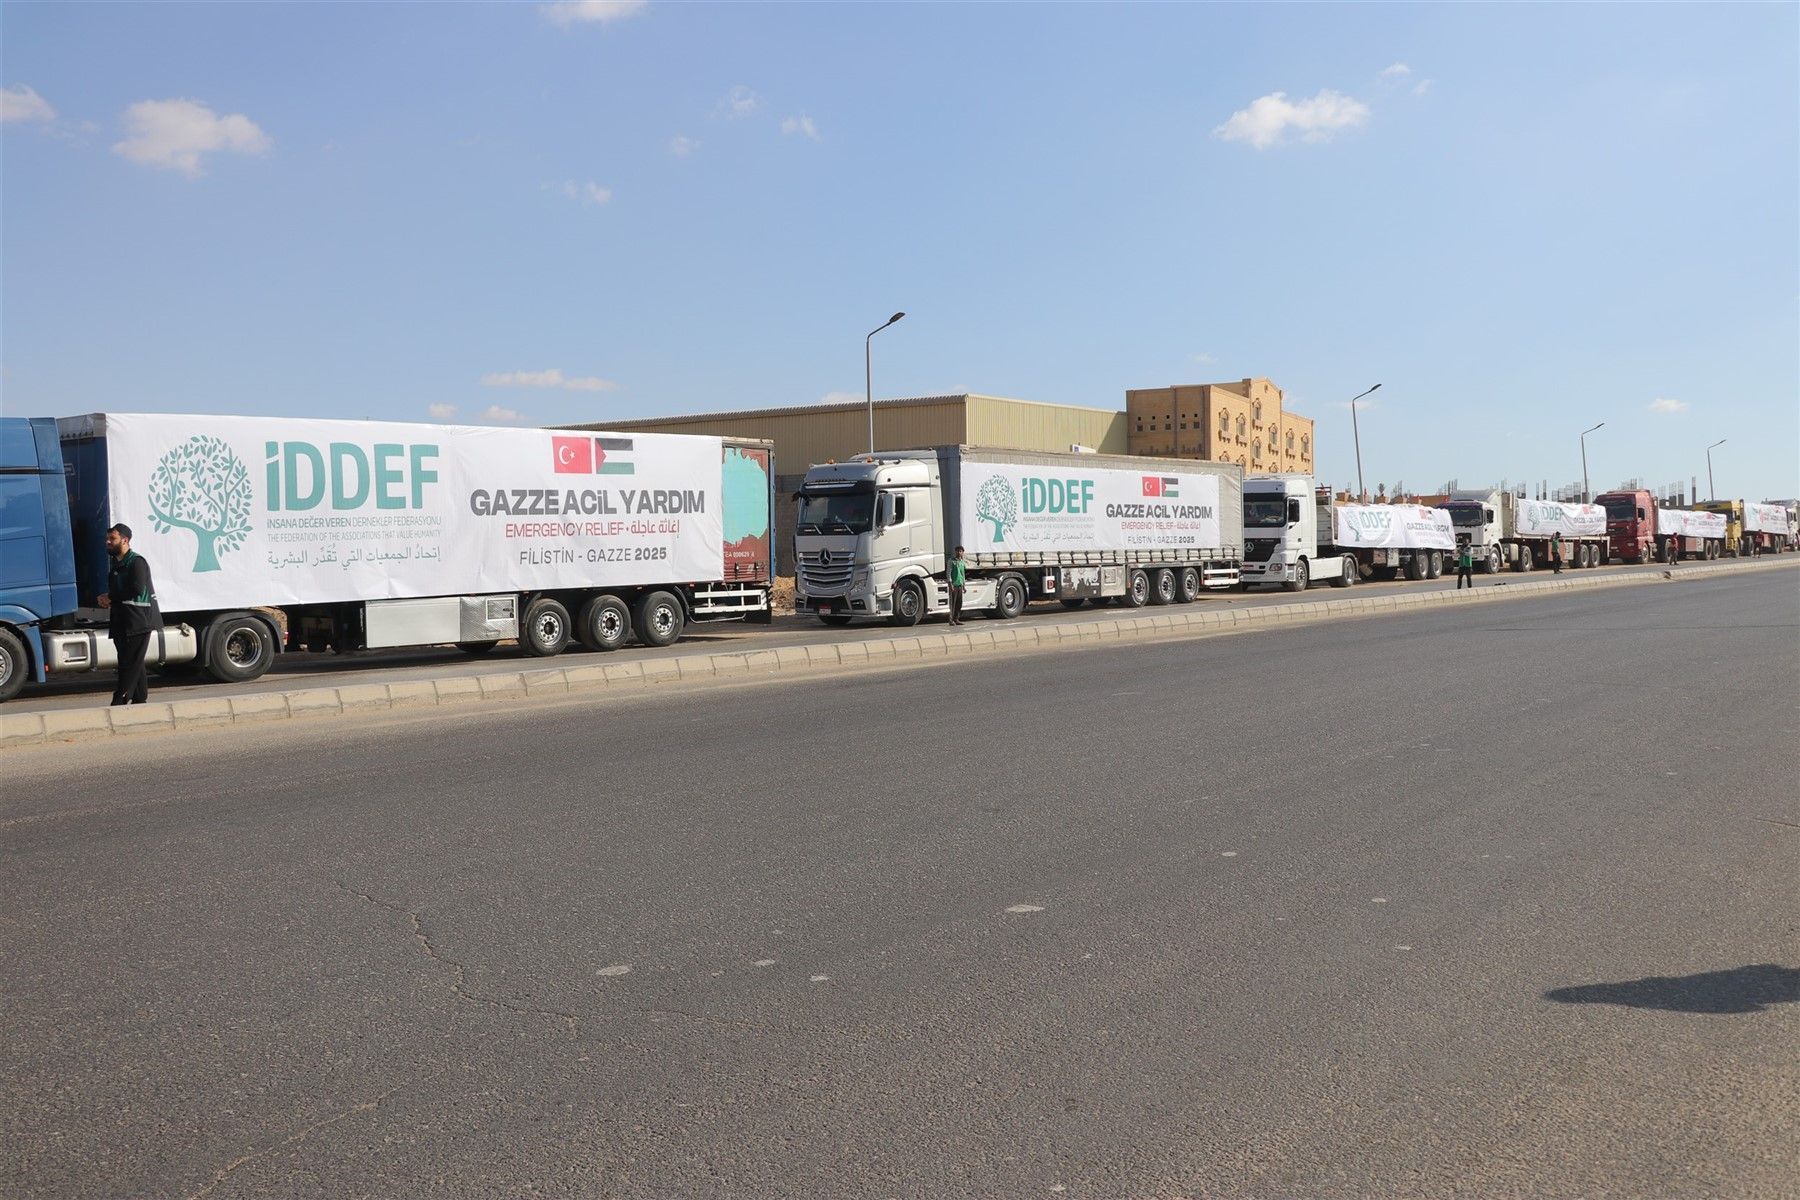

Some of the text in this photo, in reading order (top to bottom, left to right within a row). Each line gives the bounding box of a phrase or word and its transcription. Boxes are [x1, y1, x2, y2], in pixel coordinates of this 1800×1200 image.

[470, 489, 559, 516] GAZZE
[619, 489, 705, 515] YARDIM
[1105, 503, 1145, 518] GAZZE
[1172, 505, 1213, 520] YARDIM
[325, 517, 351, 527] VEREN
[393, 515, 441, 525] FEDERASYONU
[505, 521, 624, 538] EMERGENCY RELIEF
[267, 533, 279, 543] THE
[280, 532, 319, 542] FEDERATION
[587, 548, 631, 563] GAZZE
[634, 546, 667, 561] 2025
